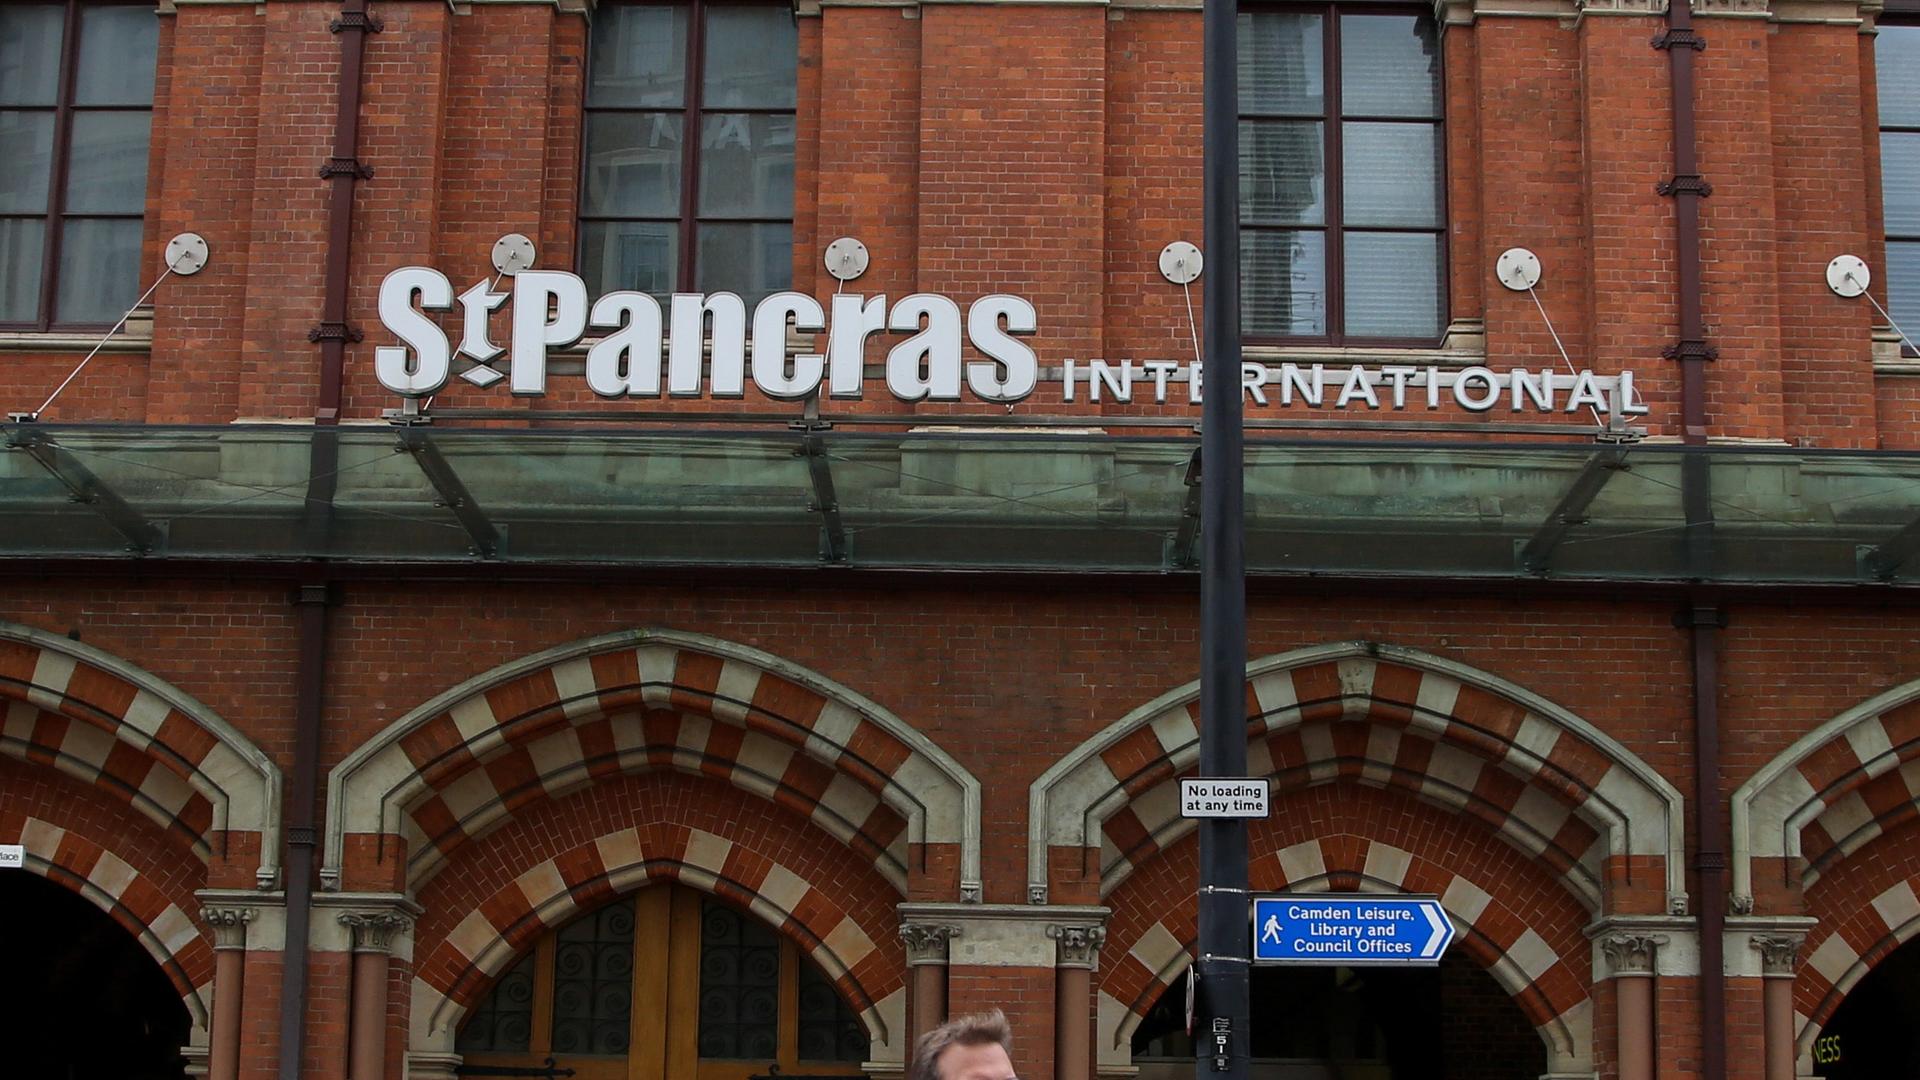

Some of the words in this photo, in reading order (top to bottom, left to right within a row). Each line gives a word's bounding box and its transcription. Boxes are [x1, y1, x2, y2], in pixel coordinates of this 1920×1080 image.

[1063, 358, 1649, 415] INTERNATIONAL
[1188, 786, 1207, 796] No
[1212, 785, 1261, 798] loading
[1187, 800, 1200, 810] at
[1205, 802, 1228, 812] any
[1234, 800, 1263, 810] time
[1288, 906, 1351, 920] Camden
[1310, 923, 1363, 938] Library
[1367, 924, 1396, 937] and
[1293, 939, 1352, 953] Council
[1357, 939, 1412, 953] Offices
